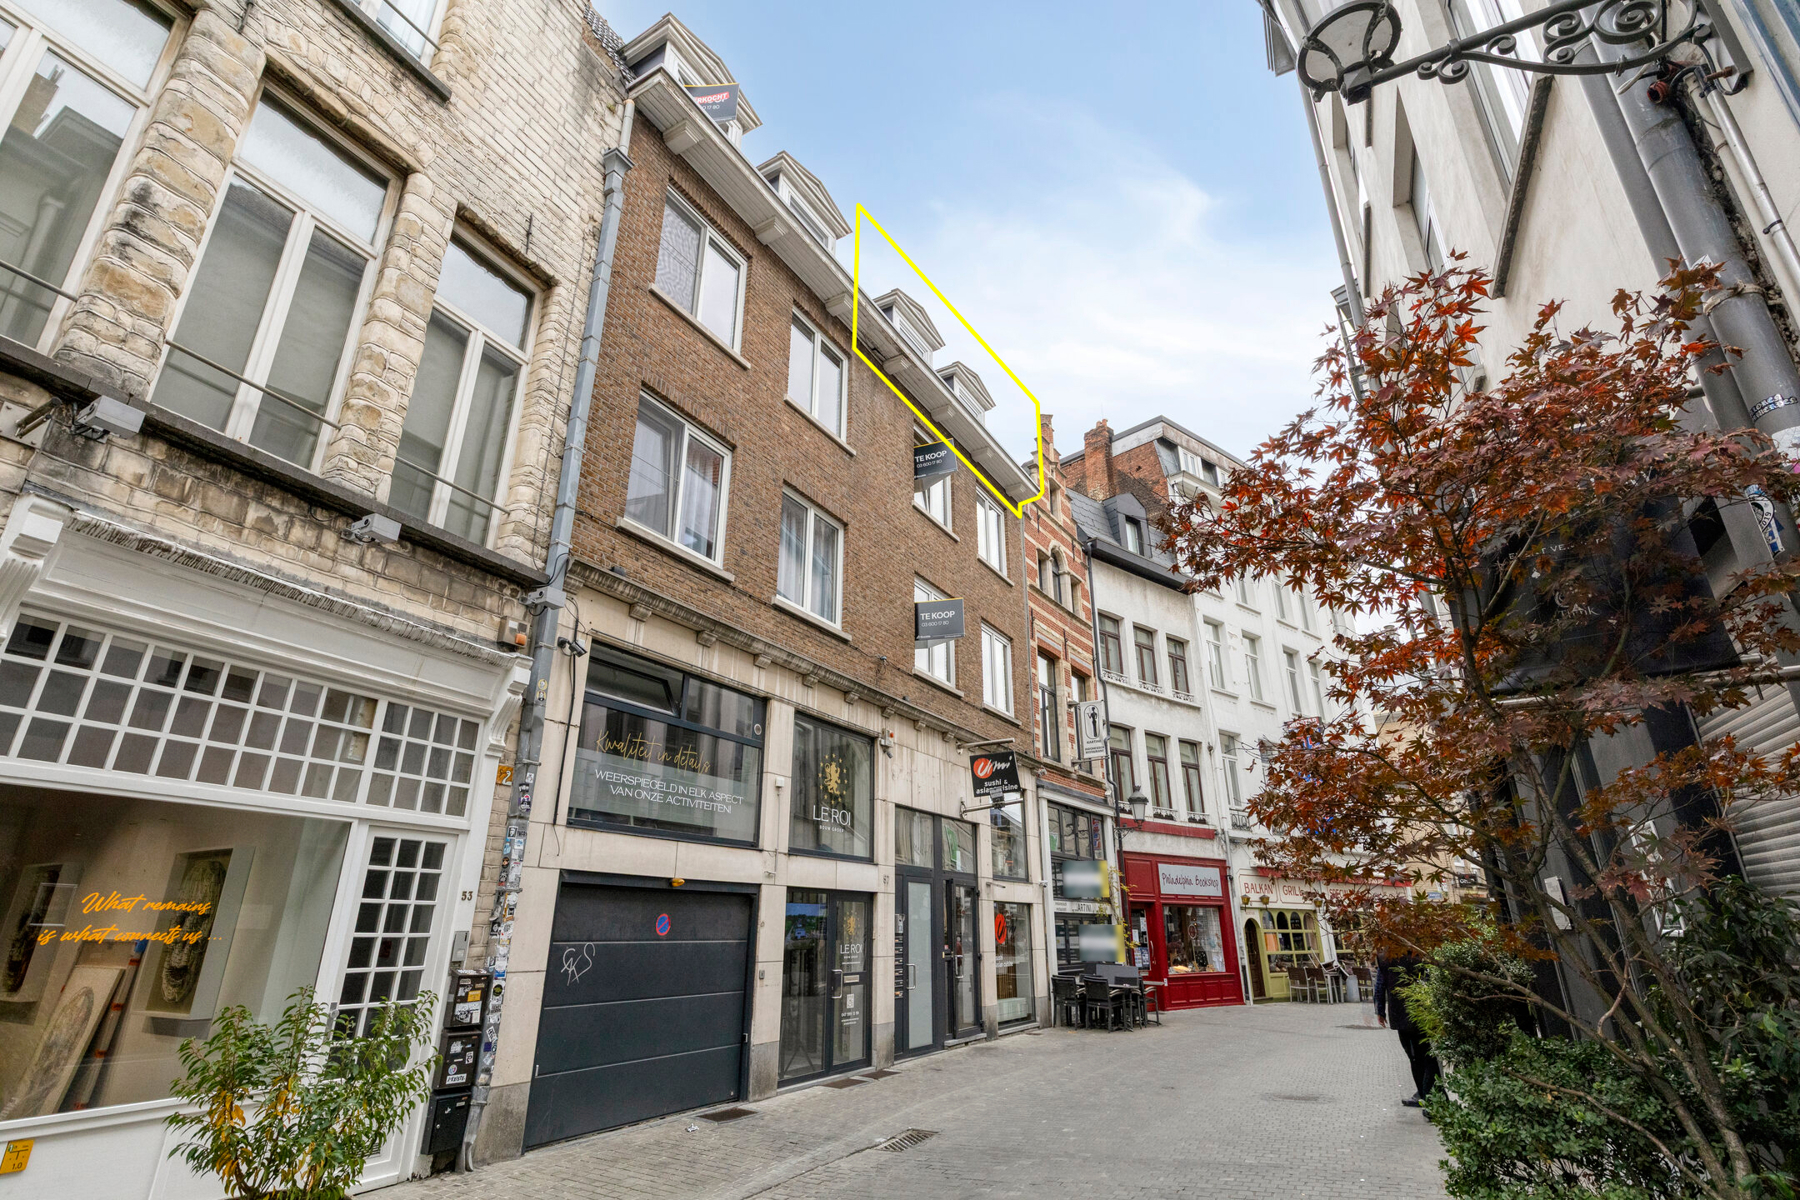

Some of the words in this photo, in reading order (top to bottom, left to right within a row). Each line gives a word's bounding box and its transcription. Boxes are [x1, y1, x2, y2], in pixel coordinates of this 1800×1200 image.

[915, 454, 924, 462] TE
[925, 450, 947, 460] KOOP
[920, 612, 930, 620] TE
[932, 610, 956, 620] KOOP
[596, 729, 662, 768] Kwaliteit
[657, 750, 672, 762] in
[673, 744, 711, 777] details
[595, 769, 678, 793] WEERSPIEGELD
[678, 784, 689, 795] IN
[689, 786, 707, 798] ELK
[708, 790, 744, 805] ASPECT
[984, 778, 1002, 787] sushi
[610, 784, 633, 797] VAN
[634, 789, 664, 803] ONZE
[812, 804, 829, 822] LE
[831, 808, 851, 826] ROI
[1244, 882, 1274, 894] BALKAN
[81, 890, 147, 914] What
[142, 900, 212, 916] remains
[460, 891, 473, 901] 53
[37, 929, 57, 946] is
[60, 924, 119, 944] what
[114, 924, 182, 944] connects
[182, 930, 203, 944] us
[12, 1161, 22, 1170] 1.0
